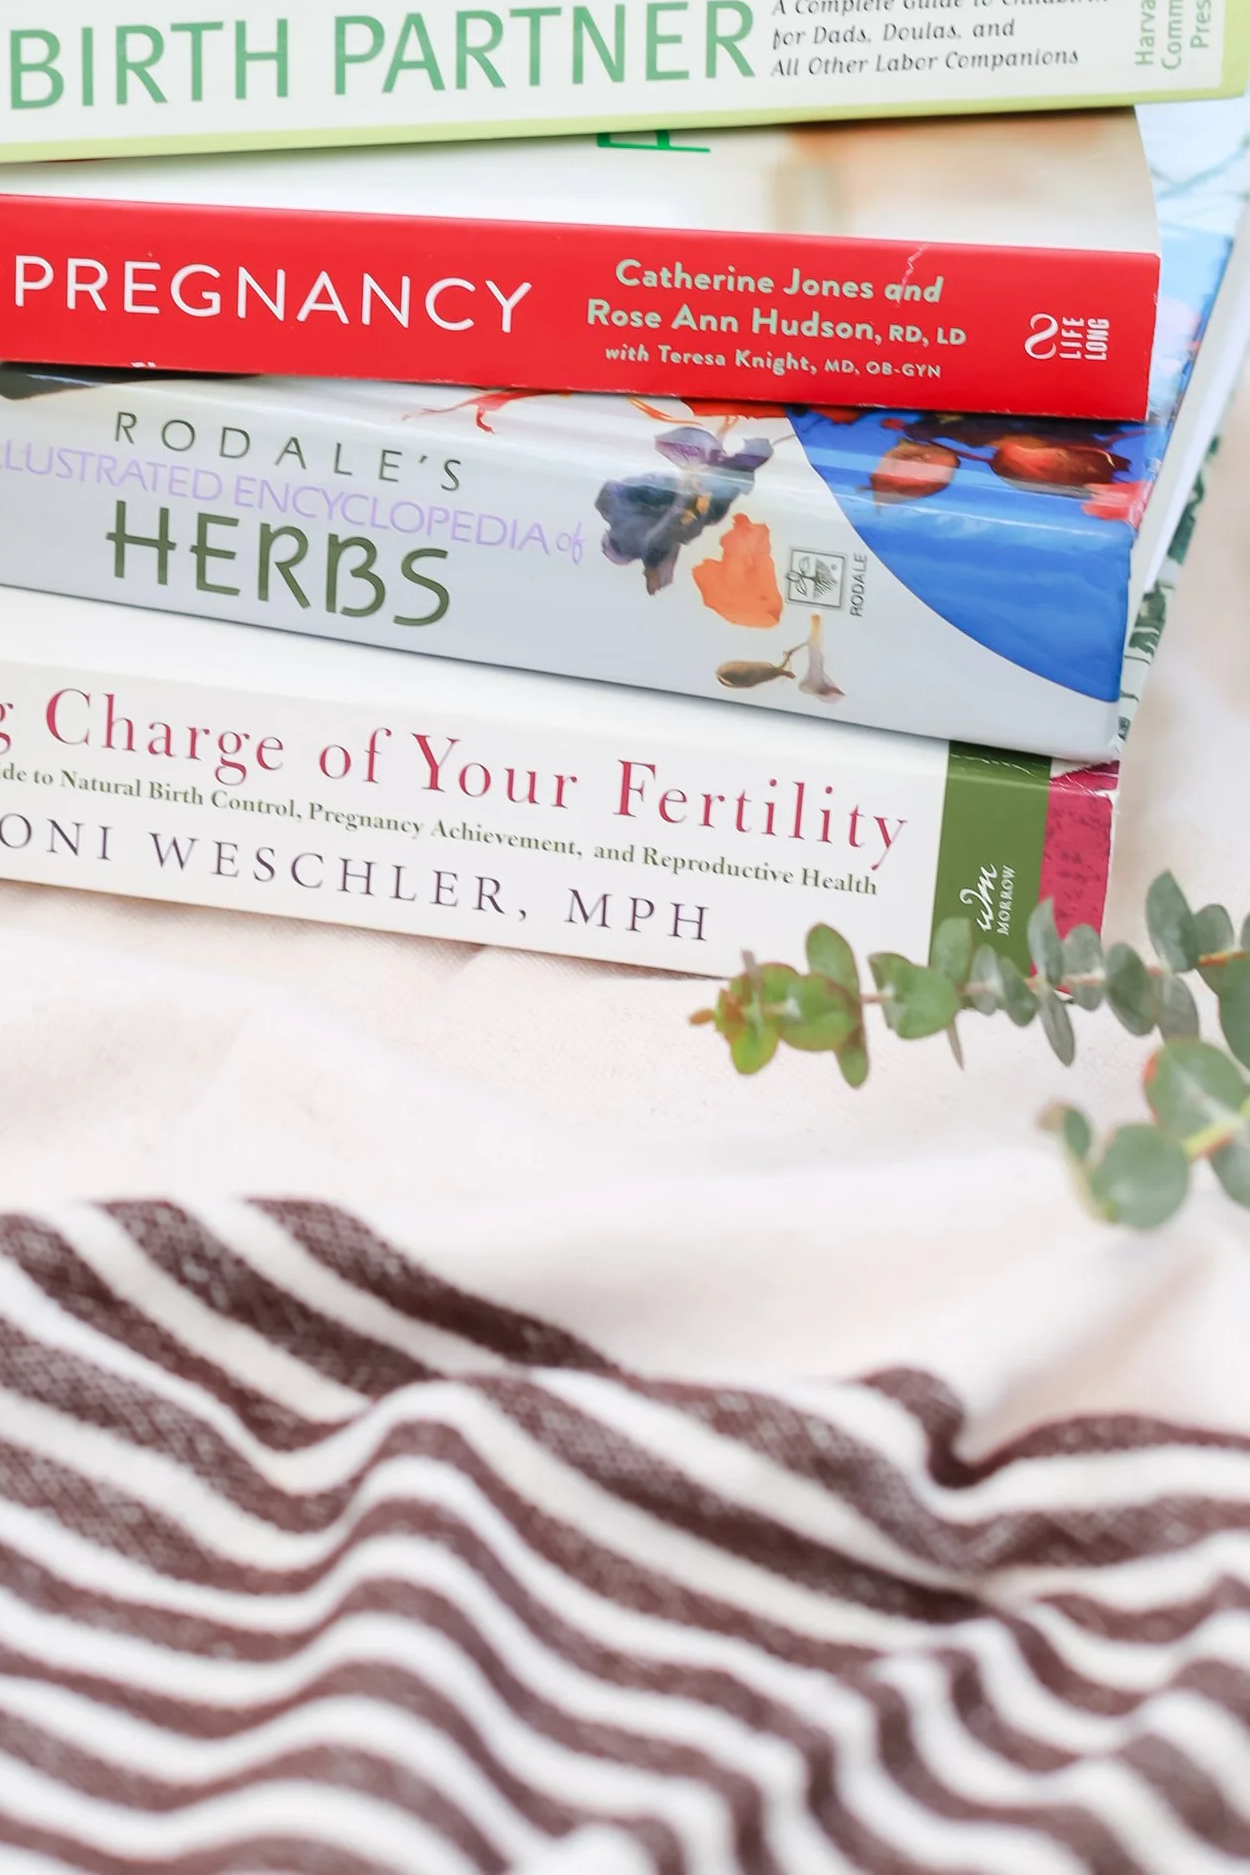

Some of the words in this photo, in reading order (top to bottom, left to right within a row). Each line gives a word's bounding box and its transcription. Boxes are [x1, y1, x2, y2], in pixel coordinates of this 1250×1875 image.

[9, 18, 289, 111] BIRTH
[770, 57, 800, 79] All
[807, 55, 869, 77] Other
[875, 52, 939, 74] Labor
[945, 47, 1080, 73] Companions
[772, 27, 807, 51] for
[813, 24, 873, 47] Dads,
[882, 20, 963, 44] Doulas,
[972, 18, 1016, 38] and
[15, 254, 533, 334] PREGNANCY
[615, 258, 775, 295] Catherine
[783, 268, 874, 301] Jones
[884, 276, 945, 304] and
[587, 298, 662, 331] Rose
[671, 304, 740, 333] Ann
[751, 308, 883, 346] Hudson,
[888, 325, 930, 348] RD,
[936, 326, 968, 347] LD
[1058, 316, 1084, 360] LIFE
[1086, 317, 1111, 361] LONG
[605, 342, 650, 363] with
[657, 344, 727, 368] Teresa
[735, 348, 818, 375] Knight,
[824, 359, 861, 377] MD,
[866, 360, 942, 379] OB-GYN
[114, 410, 463, 492] RODALE'S
[233, 474, 550, 555] ENCYCLOPEDIA
[556, 520, 586, 566] of
[105, 499, 451, 628] HERBS
[850, 552, 868, 618] RODALE
[45, 686, 284, 787] Charge
[318, 726, 392, 785] of
[411, 731, 579, 809] Your
[612, 758, 909, 872] Fertility
[33, 768, 55, 787] to
[60, 769, 142, 799] Natural
[149, 780, 204, 807] Birth
[210, 790, 303, 822] Control,
[308, 802, 424, 841] Pregnancy
[430, 817, 583, 860] Achievement,
[593, 841, 636, 865] and
[643, 845, 794, 886] Reproductive
[801, 867, 878, 897] Health
[148, 831, 528, 923] WESCHLER,
[563, 888, 710, 943] MPH
[996, 864, 1016, 937] MORROW
